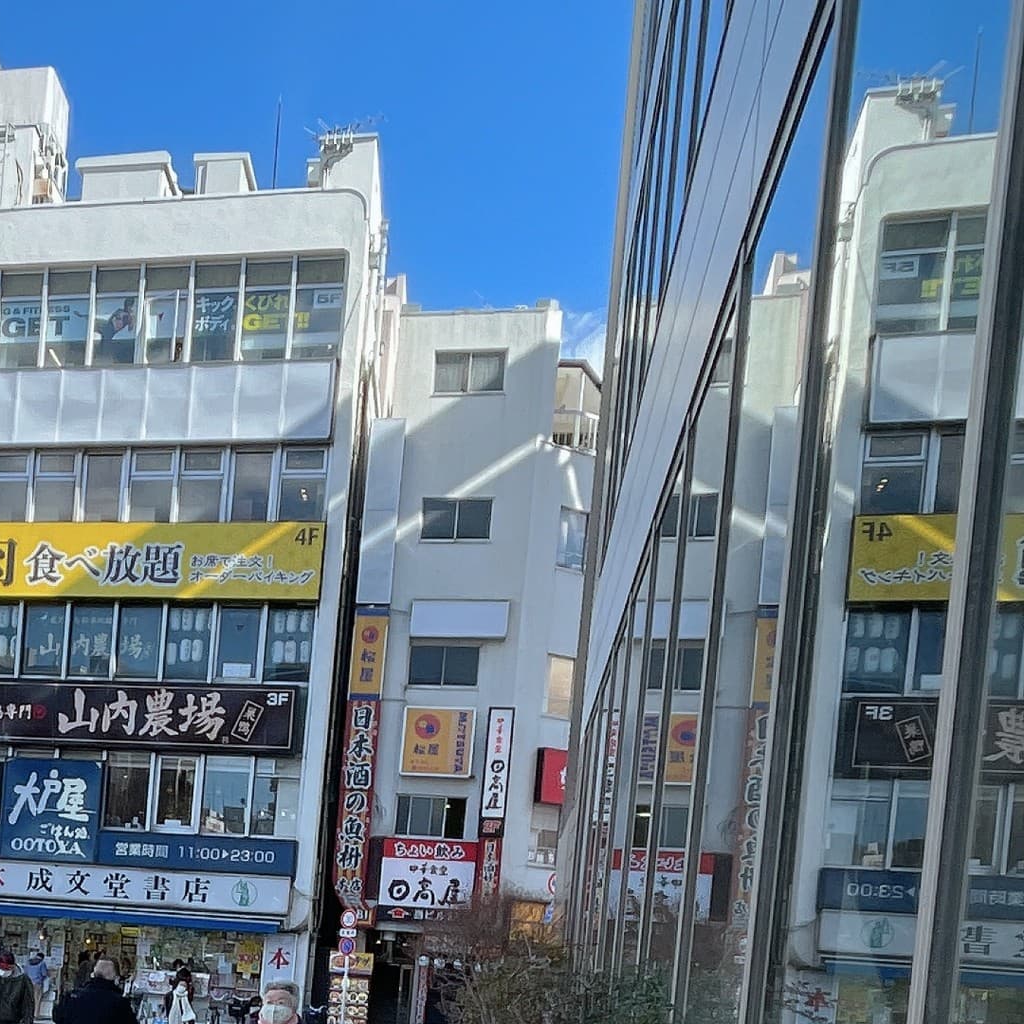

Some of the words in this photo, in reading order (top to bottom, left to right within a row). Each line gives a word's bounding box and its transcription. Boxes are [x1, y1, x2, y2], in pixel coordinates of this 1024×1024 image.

[294, 527, 320, 546] 4F
[26, 542, 182, 587] 食べ放題
[189, 569, 314, 585] オーダーバイキング
[359, 648, 376, 682] 松屋
[266, 692, 289, 706] 3F
[57, 687, 227, 741] 山内農場
[8, 769, 90, 824] 大戸屋
[10, 837, 87, 858] OOTOYA
[115, 841, 169, 859] 営業時間
[178, 844, 221, 860] 11:00
[229, 848, 275, 864] 23:00
[394, 841, 466, 860] ちょい飲み
[26, 867, 212, 904] 成文堂書店
[387, 878, 469, 907] 日高屋
